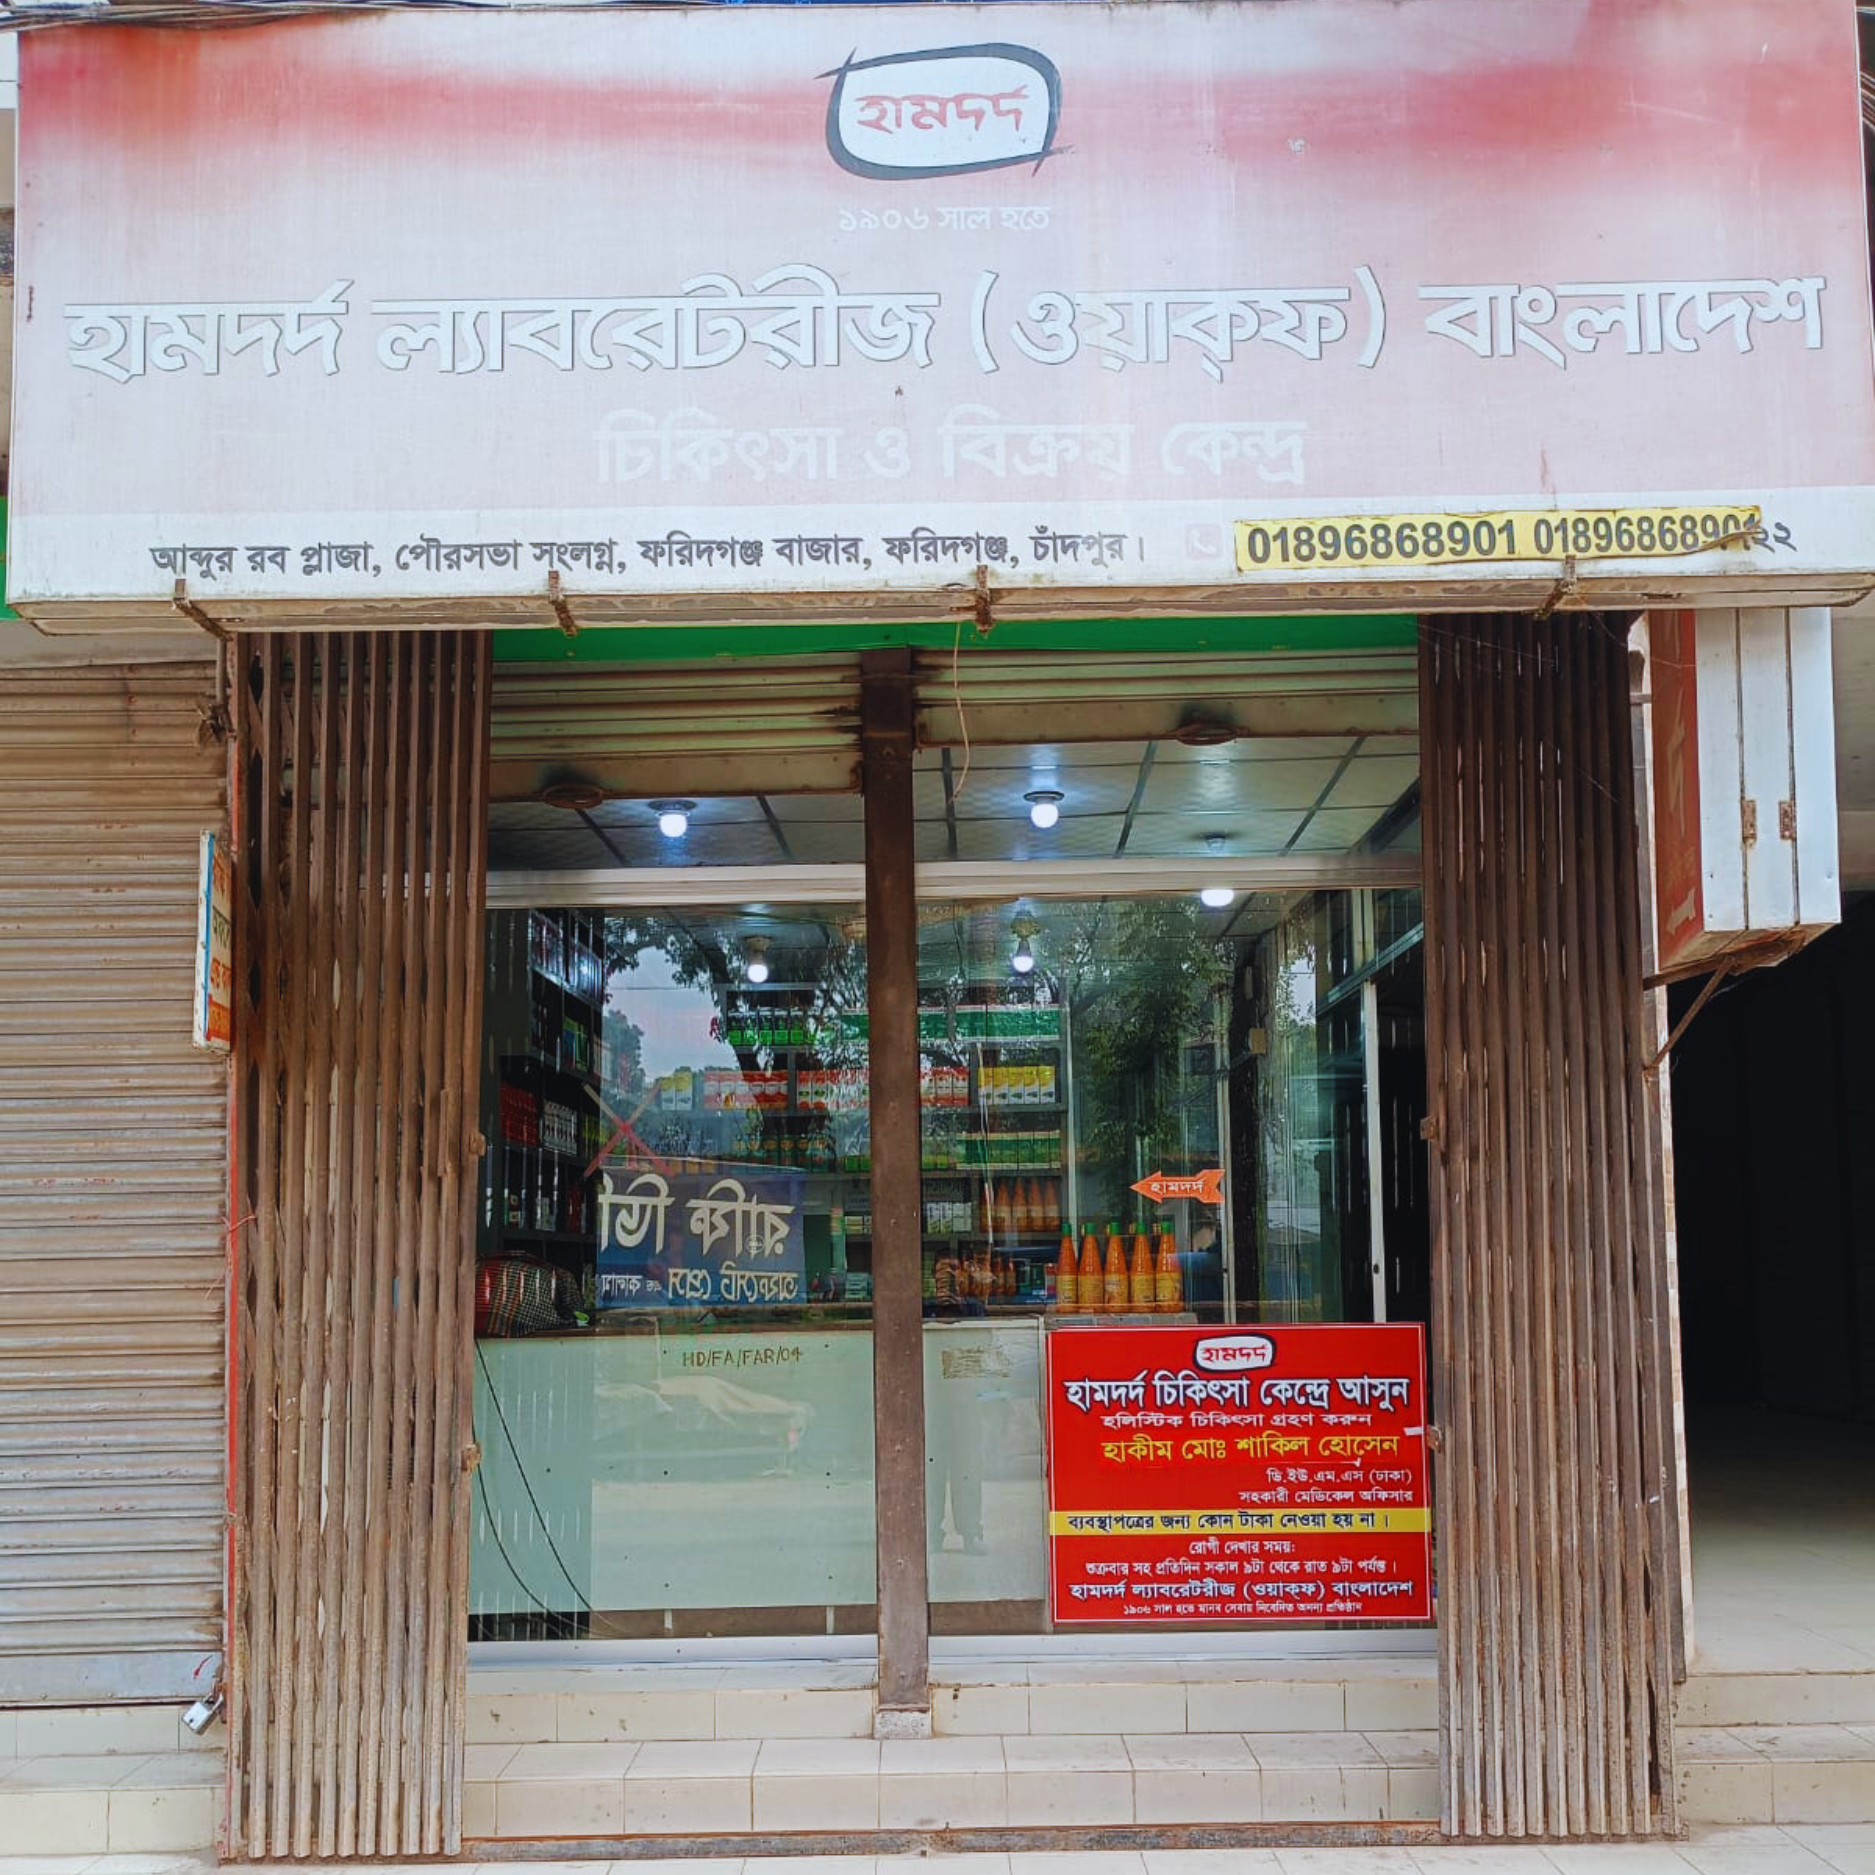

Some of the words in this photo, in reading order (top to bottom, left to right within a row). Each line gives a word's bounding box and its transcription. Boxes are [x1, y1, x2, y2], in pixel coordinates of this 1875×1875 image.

[854, 84, 1029, 134] হামদর্দ
[838, 208, 930, 231] ১৯০৬
[937, 207, 991, 230] সাল
[1000, 206, 1050, 230] হতে
[64, 280, 354, 384] হামদর্দ
[371, 263, 941, 374] ল্যাবরেটরীজ
[1419, 275, 1826, 369] বাংলাদেশ
[593, 406, 842, 483] চিকিৎসা
[863, 427, 912, 479] ও
[938, 403, 1135, 482] বিক্রয়
[1160, 420, 1309, 485] কেন্দ্র
[150, 543, 237, 580] আব্দুর
[245, 545, 290, 573] রব
[300, 541, 381, 577] প্লাজা,
[396, 533, 522, 571] পৌরসভা
[531, 538, 626, 575] সংলগ্ন,
[637, 529, 763, 567] ফরিদগঞ্জ
[772, 533, 872, 570] বাজার,
[882, 526, 1018, 569] ফরিদগঞ্জ,
[1030, 525, 1126, 567] চাঁদপুর
[1247, 519, 1516, 564] 01896868901
[1148, 1179, 1206, 1195] হামদর্দ
[1201, 1344, 1268, 1362] হামদর্দ
[1063, 1369, 1149, 1412] হামদর্দ
[1152, 1369, 1250, 1408] চিকিৎসা
[1260, 1378, 1331, 1410] কেন্দ্রে
[1336, 1375, 1411, 1412] আসুন
[1100, 1411, 1184, 1429] হলিস্টিক
[1190, 1411, 1265, 1428] চিকিৎসা
[1270, 1412, 1315, 1427] গ্রহণ
[1320, 1414, 1372, 1427] করুন
[1101, 1433, 1173, 1463] হাকীম
[1182, 1437, 1226, 1459] মোঃ
[1234, 1430, 1311, 1458] শাকিল
[1319, 1434, 1399, 1458] হোসেন
[1266, 1467, 1363, 1483] ডি.ইউ.এম.এস
[1369, 1469, 1412, 1484] (ঢাকা)
[1239, 1486, 1289, 1503] সহকারী
[1294, 1487, 1354, 1502] মেডিকেল
[1359, 1487, 1413, 1502] অফিসার
[1068, 1513, 1154, 1532] ব্যবস্থাপত্রের
[1161, 1514, 1190, 1529] জন্য
[1198, 1514, 1233, 1528] কোন
[1238, 1509, 1273, 1528] টাকা
[1280, 1513, 1326, 1528] নেওয়া
[1332, 1513, 1353, 1528] হয়
[1359, 1513, 1375, 1527] না
[1189, 1536, 1220, 1554] রোগী
[1225, 1541, 1259, 1553] দেখার
[1086, 1562, 1129, 1575] শুক্রবার
[1133, 1561, 1153, 1576] সহ
[1156, 1557, 1200, 1575] প্রতিদিন
[1204, 1560, 1239, 1574] সকাল
[1243, 1557, 1264, 1573] ৯টা
[1270, 1560, 1301, 1573] থেকে
[1304, 1559, 1328, 1573] রাত
[1332, 1556, 1353, 1573] ৯টা
[1358, 1555, 1387, 1573] পর্যন্ত
[1069, 1579, 1128, 1601] হামদর্দ
[1131, 1576, 1236, 1598] ল্যাবরেটরীজ
[1331, 1579, 1413, 1597] বাংলাদেশ
[1153, 1603, 1172, 1614] সাল
[1175, 1603, 1195, 1615] হতে
